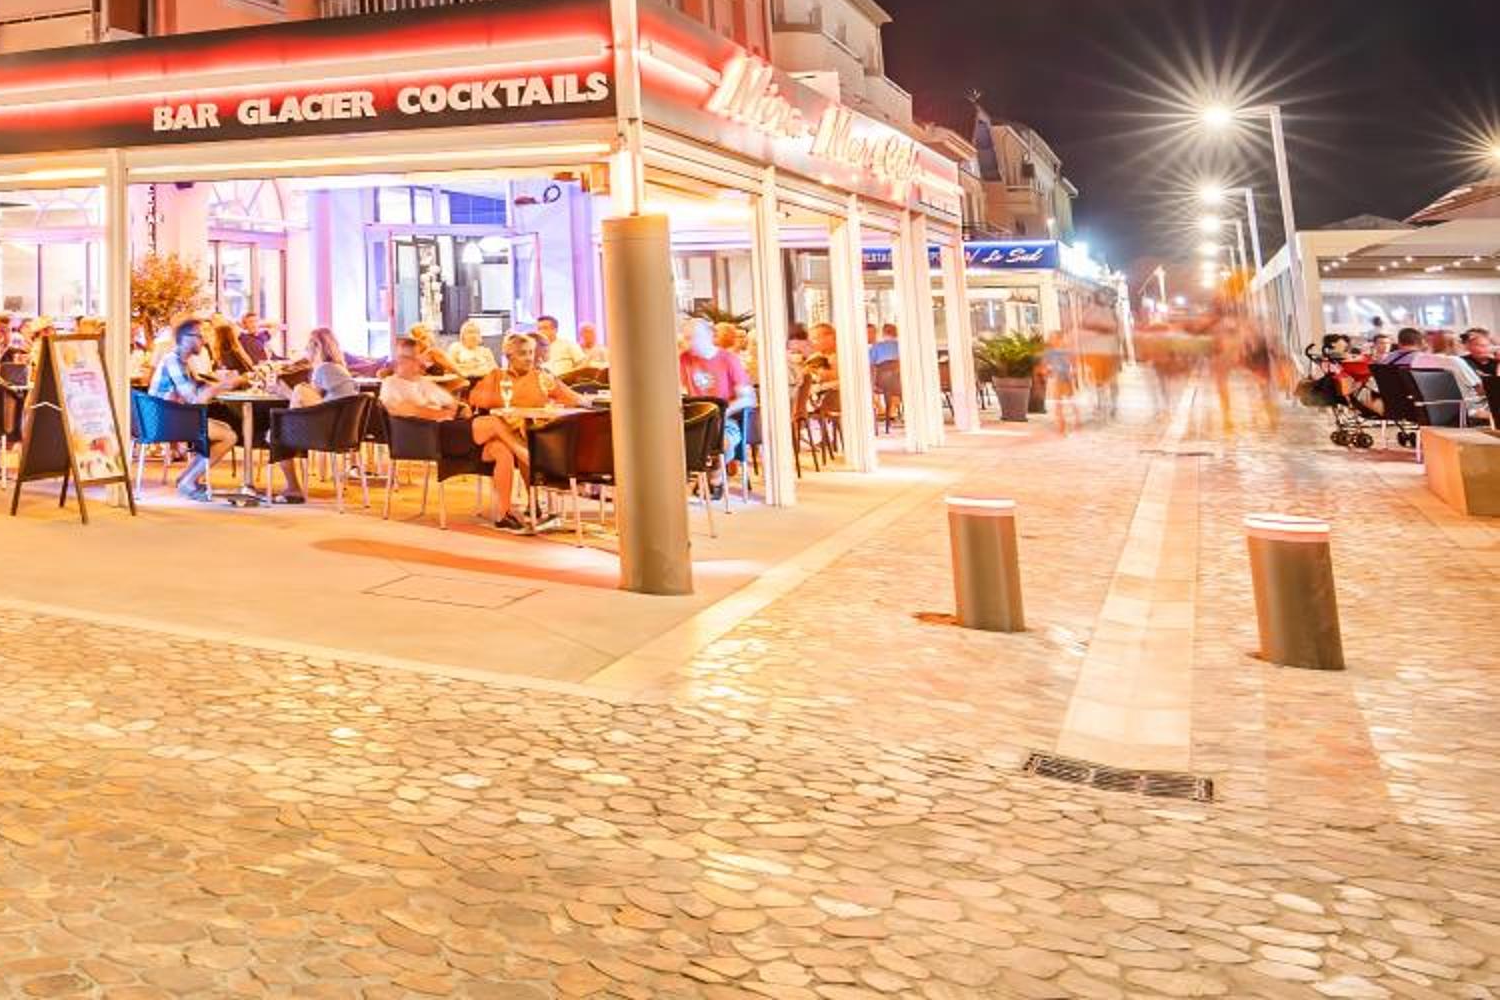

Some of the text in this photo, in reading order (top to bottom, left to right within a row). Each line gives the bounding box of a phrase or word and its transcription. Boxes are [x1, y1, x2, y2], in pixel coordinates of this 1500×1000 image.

[152, 72, 610, 132] BAR GLACIER COCKTAILS
